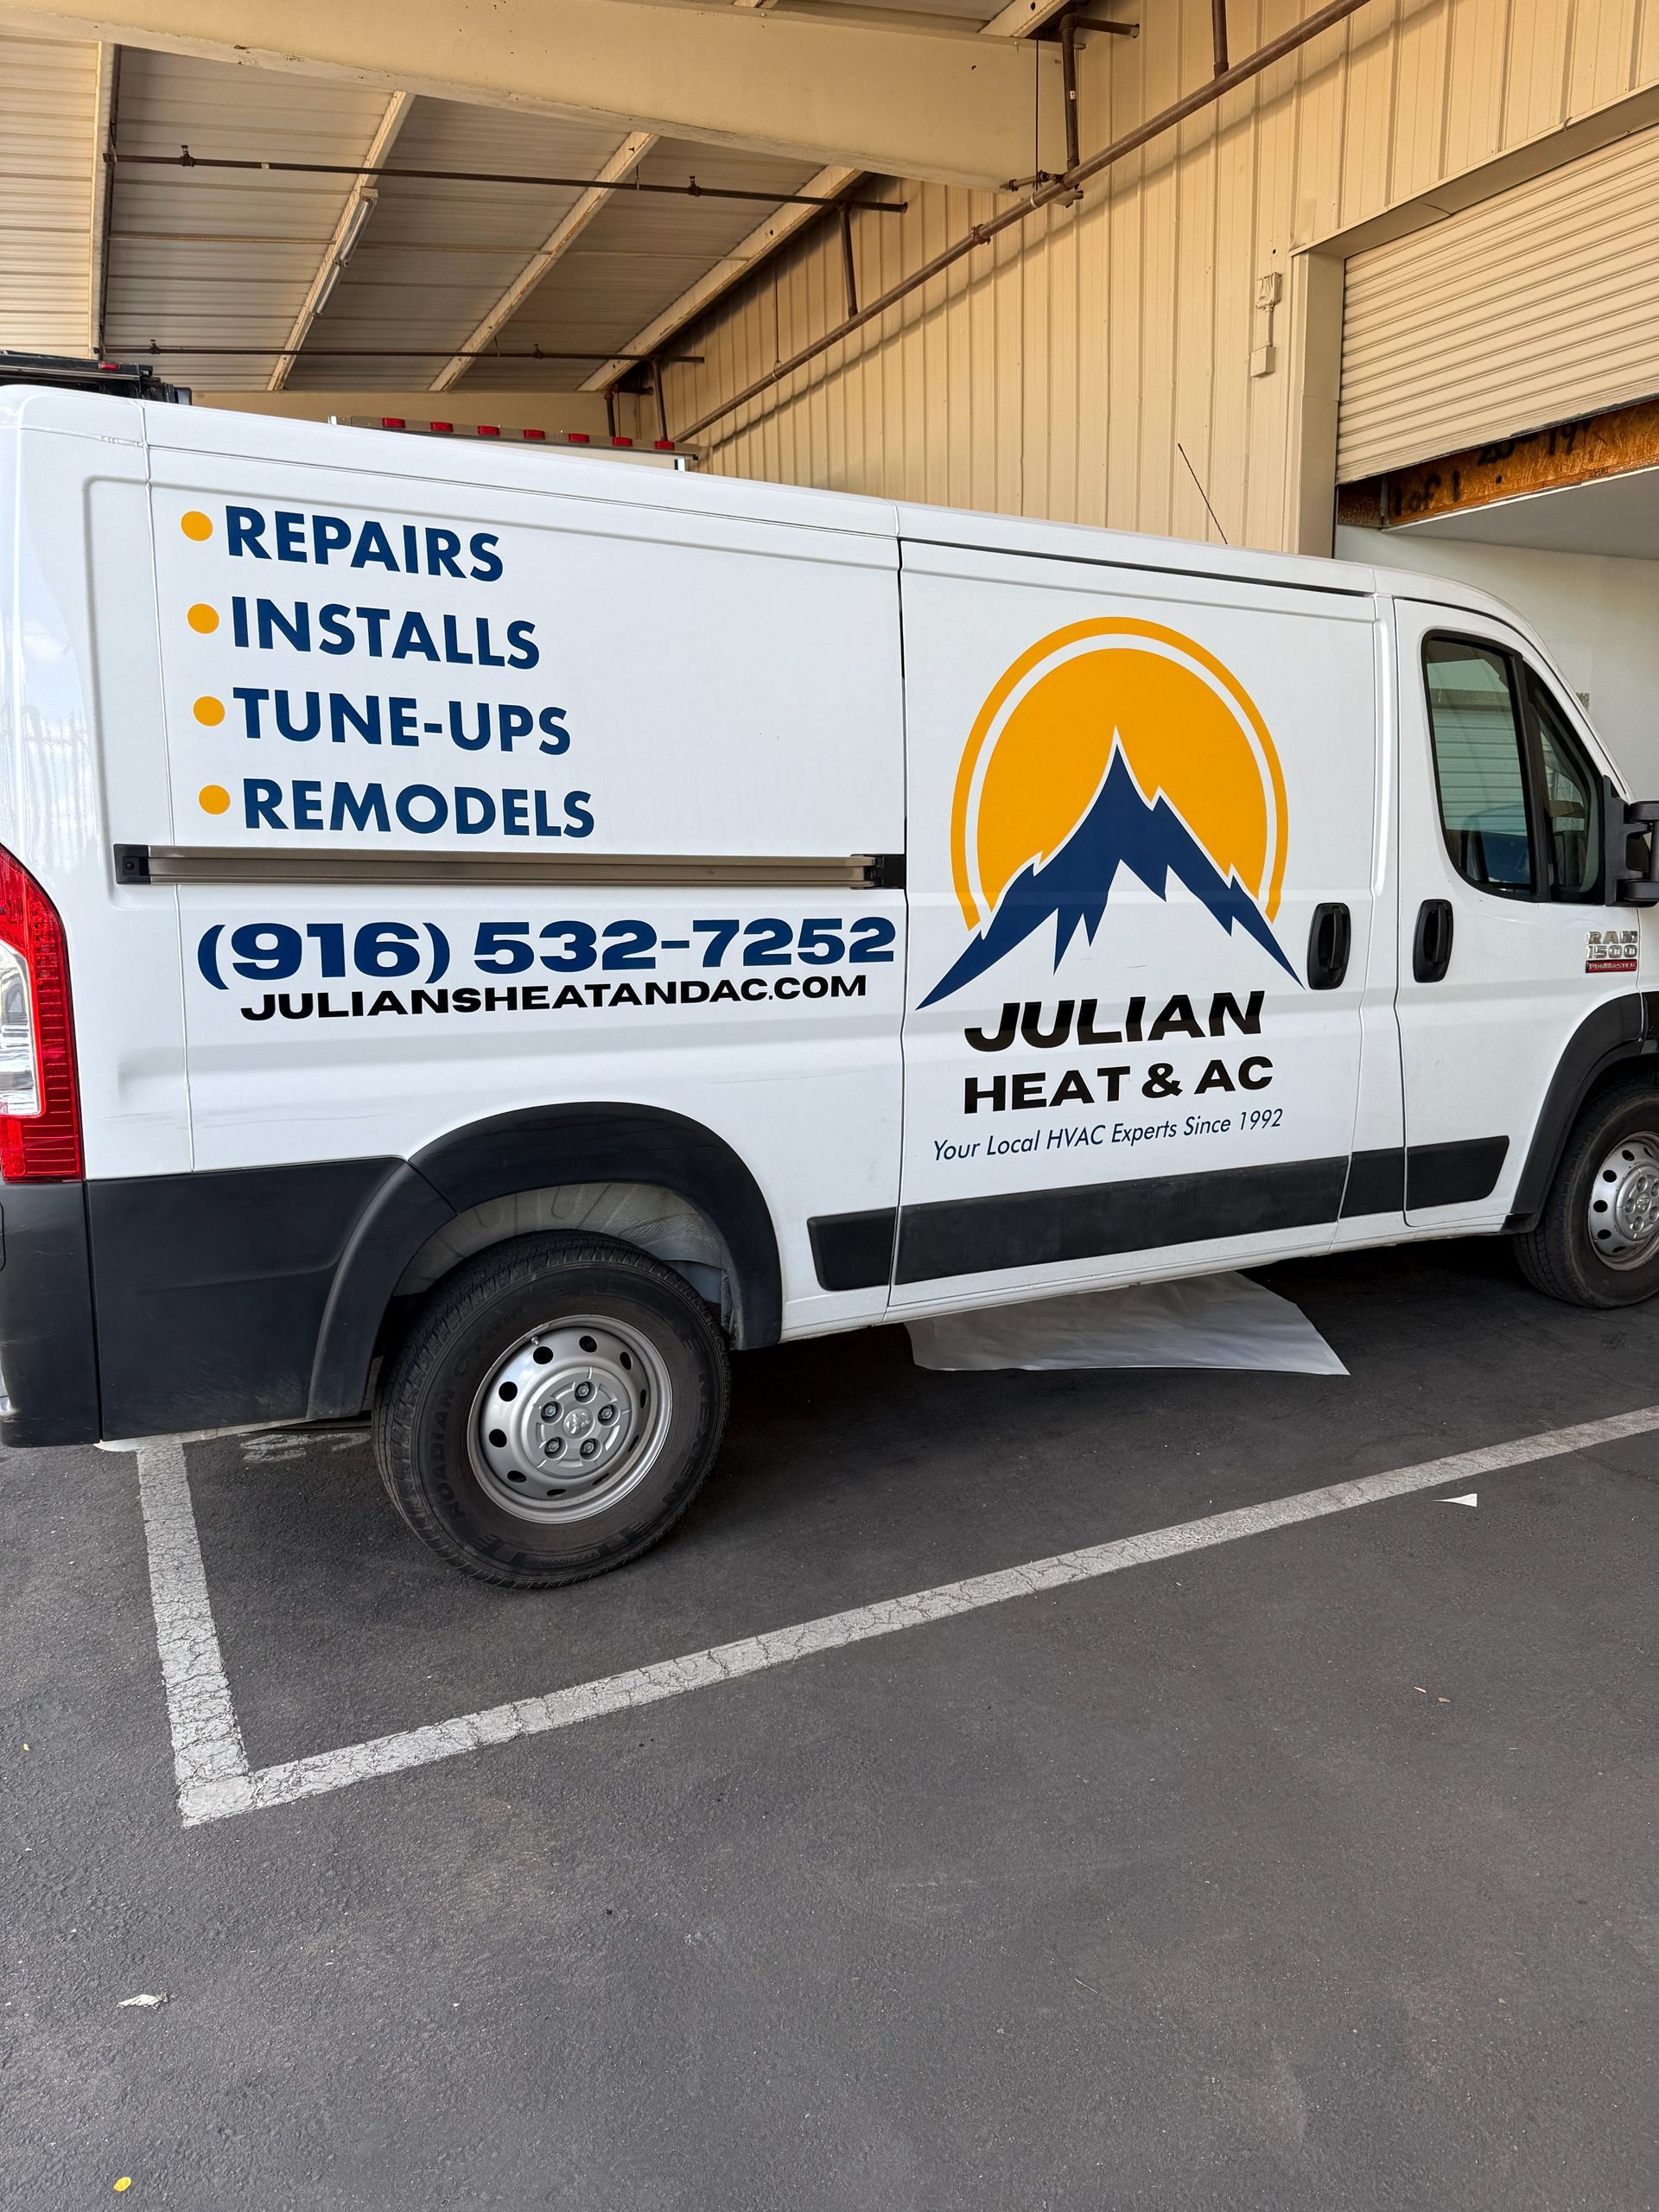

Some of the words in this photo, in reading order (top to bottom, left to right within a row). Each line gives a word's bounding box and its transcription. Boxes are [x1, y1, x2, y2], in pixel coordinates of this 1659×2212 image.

[226, 505, 503, 582] REPAIRS
[232, 596, 539, 669] INSTALLS
[233, 687, 570, 755] TUNE-UPS
[244, 779, 594, 837] REMODELS
[198, 922, 450, 989] (916)
[474, 917, 895, 974] 532-7252
[1586, 931, 1638, 944] RAM
[1586, 944, 1637, 959] 1500
[241, 976, 866, 1020] JULIANSHEATANDAC.COM
[964, 991, 1265, 1052] JULIAN
[964, 1066, 1130, 1114] HEAT
[1142, 1063, 1182, 1098] &
[1194, 1056, 1273, 1094] AC
[934, 1140, 980, 1160] Your
[987, 1130, 1040, 1155] Local
[1047, 1125, 1105, 1149] HVAC
[1112, 1121, 1177, 1146] Experts
[1184, 1116, 1230, 1135] Since
[1241, 1109, 1282, 1129] 1992
